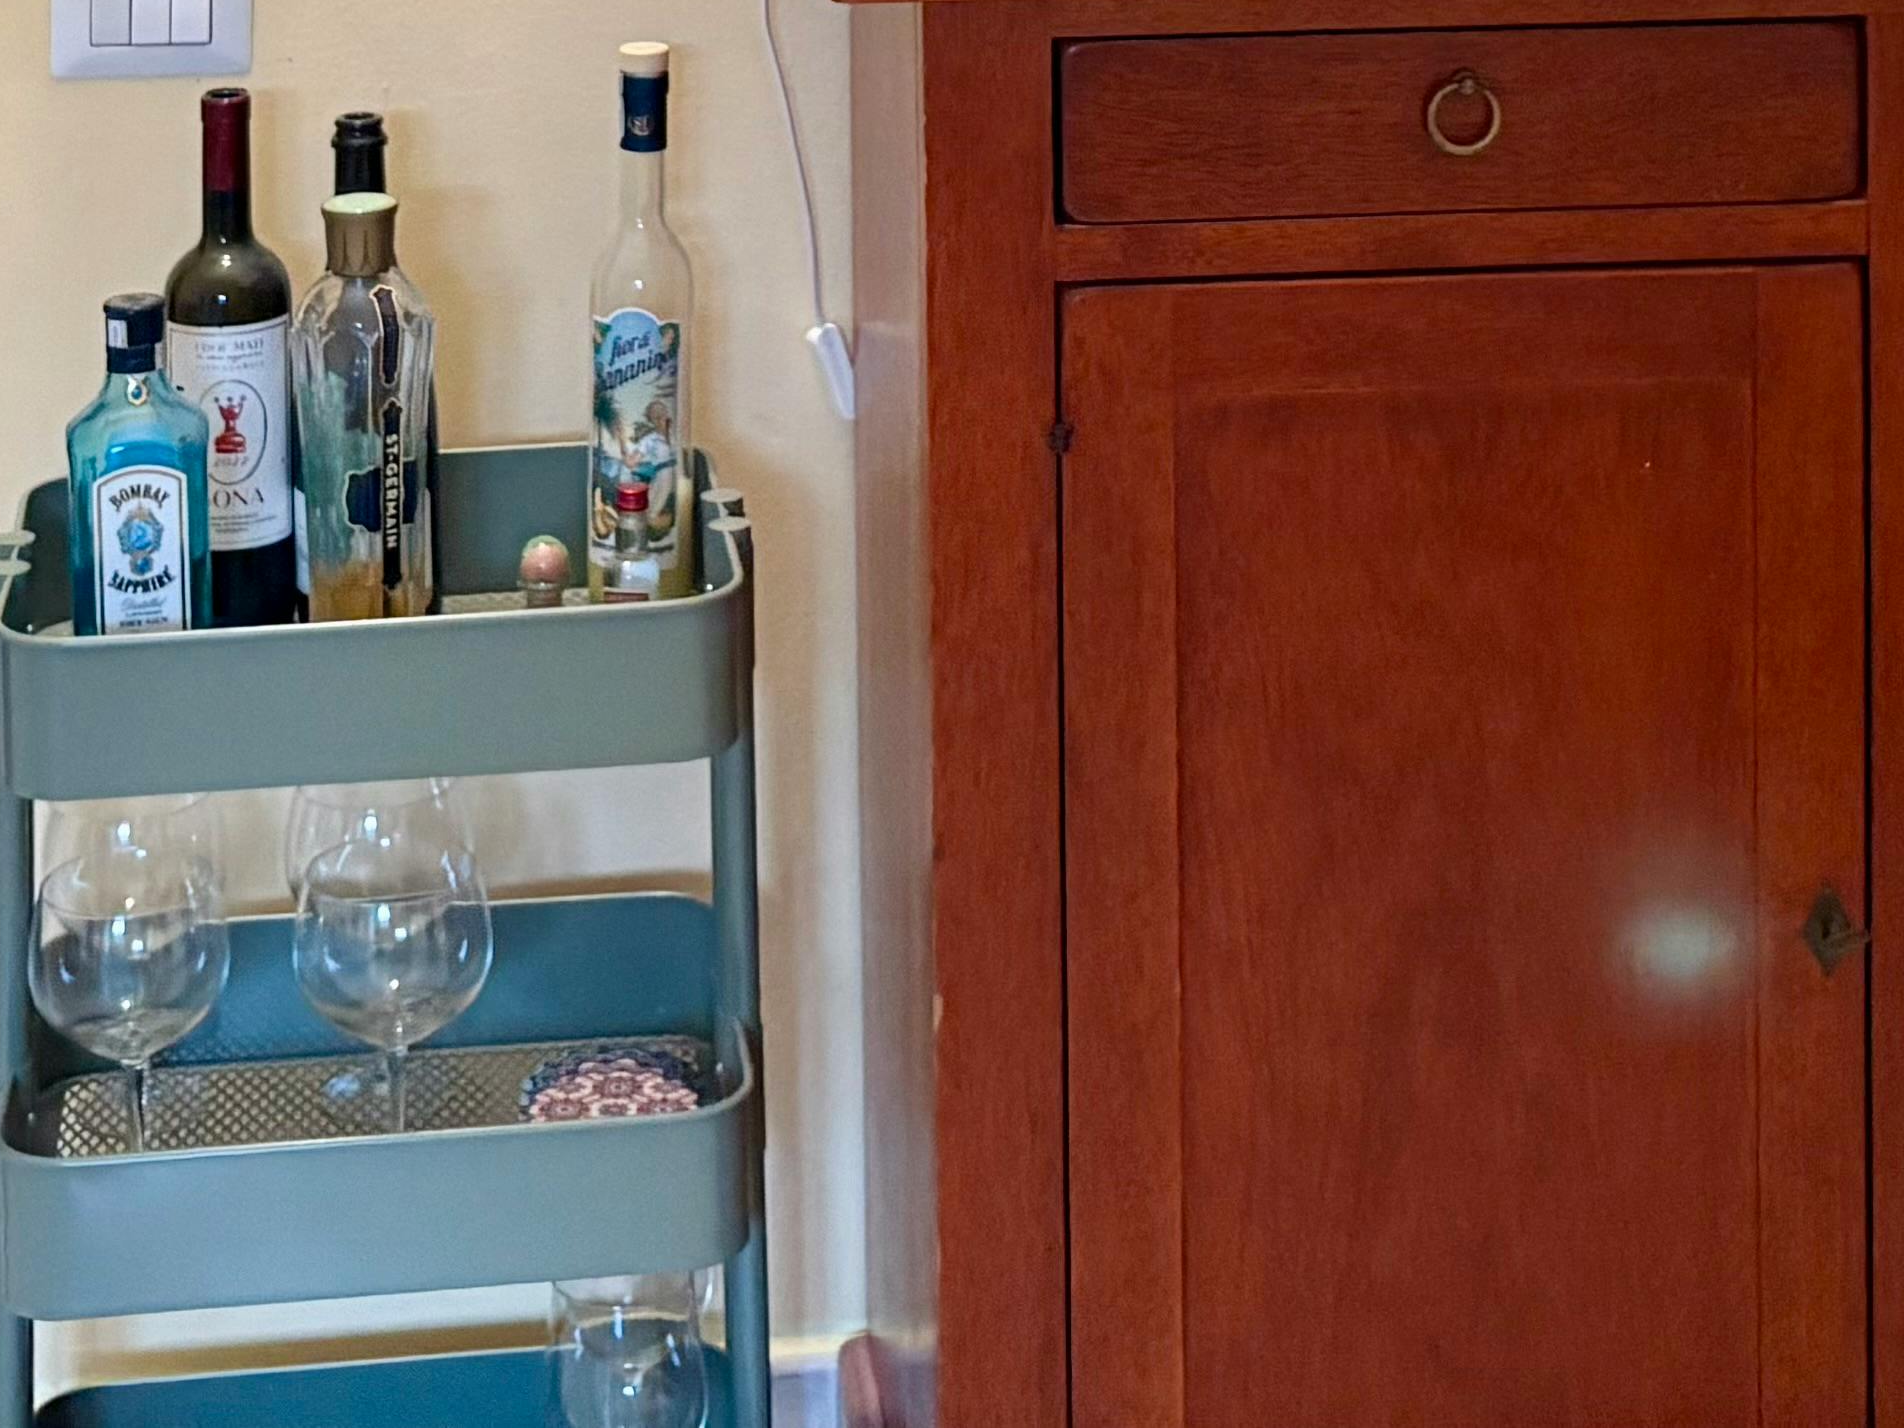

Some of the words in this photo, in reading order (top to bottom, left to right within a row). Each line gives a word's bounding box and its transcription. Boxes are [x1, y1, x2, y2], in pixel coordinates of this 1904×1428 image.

[109, 484, 171, 512] BOMBAY
[211, 488, 265, 510] ONA
[107, 564, 176, 594] SAPPHIRE
